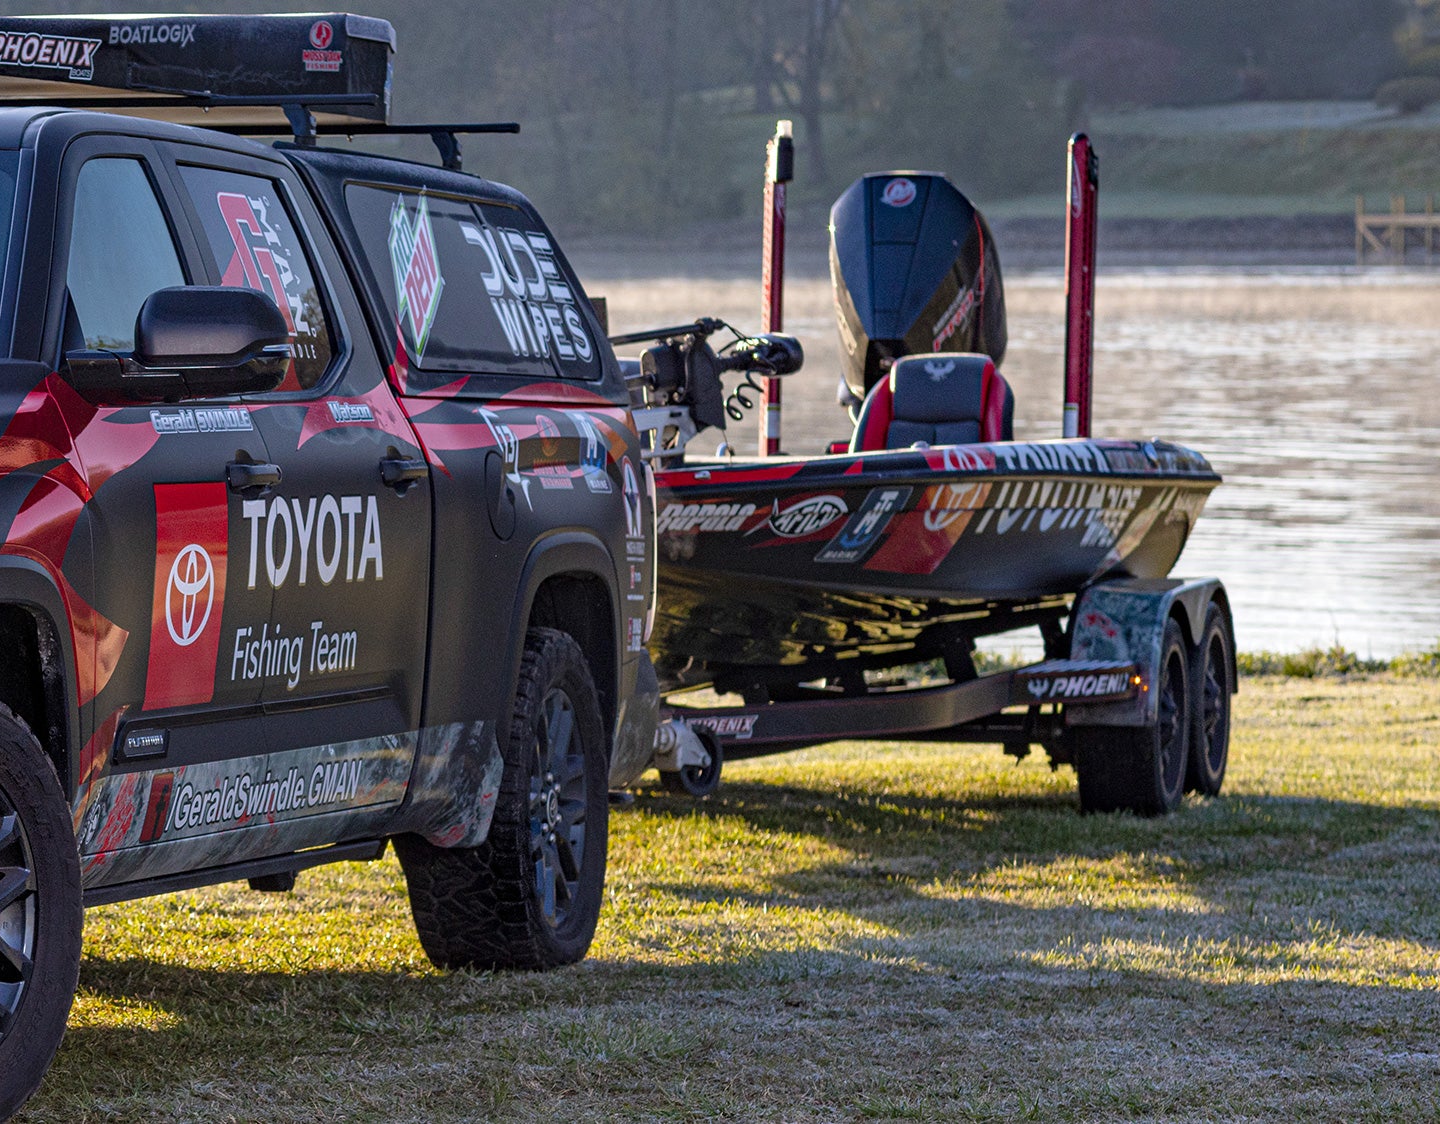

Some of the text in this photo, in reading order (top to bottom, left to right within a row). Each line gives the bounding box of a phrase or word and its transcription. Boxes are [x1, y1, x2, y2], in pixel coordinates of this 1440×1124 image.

[109, 24, 196, 46] BOATLOGIX
[459, 220, 574, 304] DUDE
[490, 297, 593, 363] WIPES
[151, 408, 253, 433] Gerald SWINDLE
[327, 402, 375, 423] Watson
[242, 494, 384, 590] TOYOTA
[231, 621, 358, 689] Fishing Team
